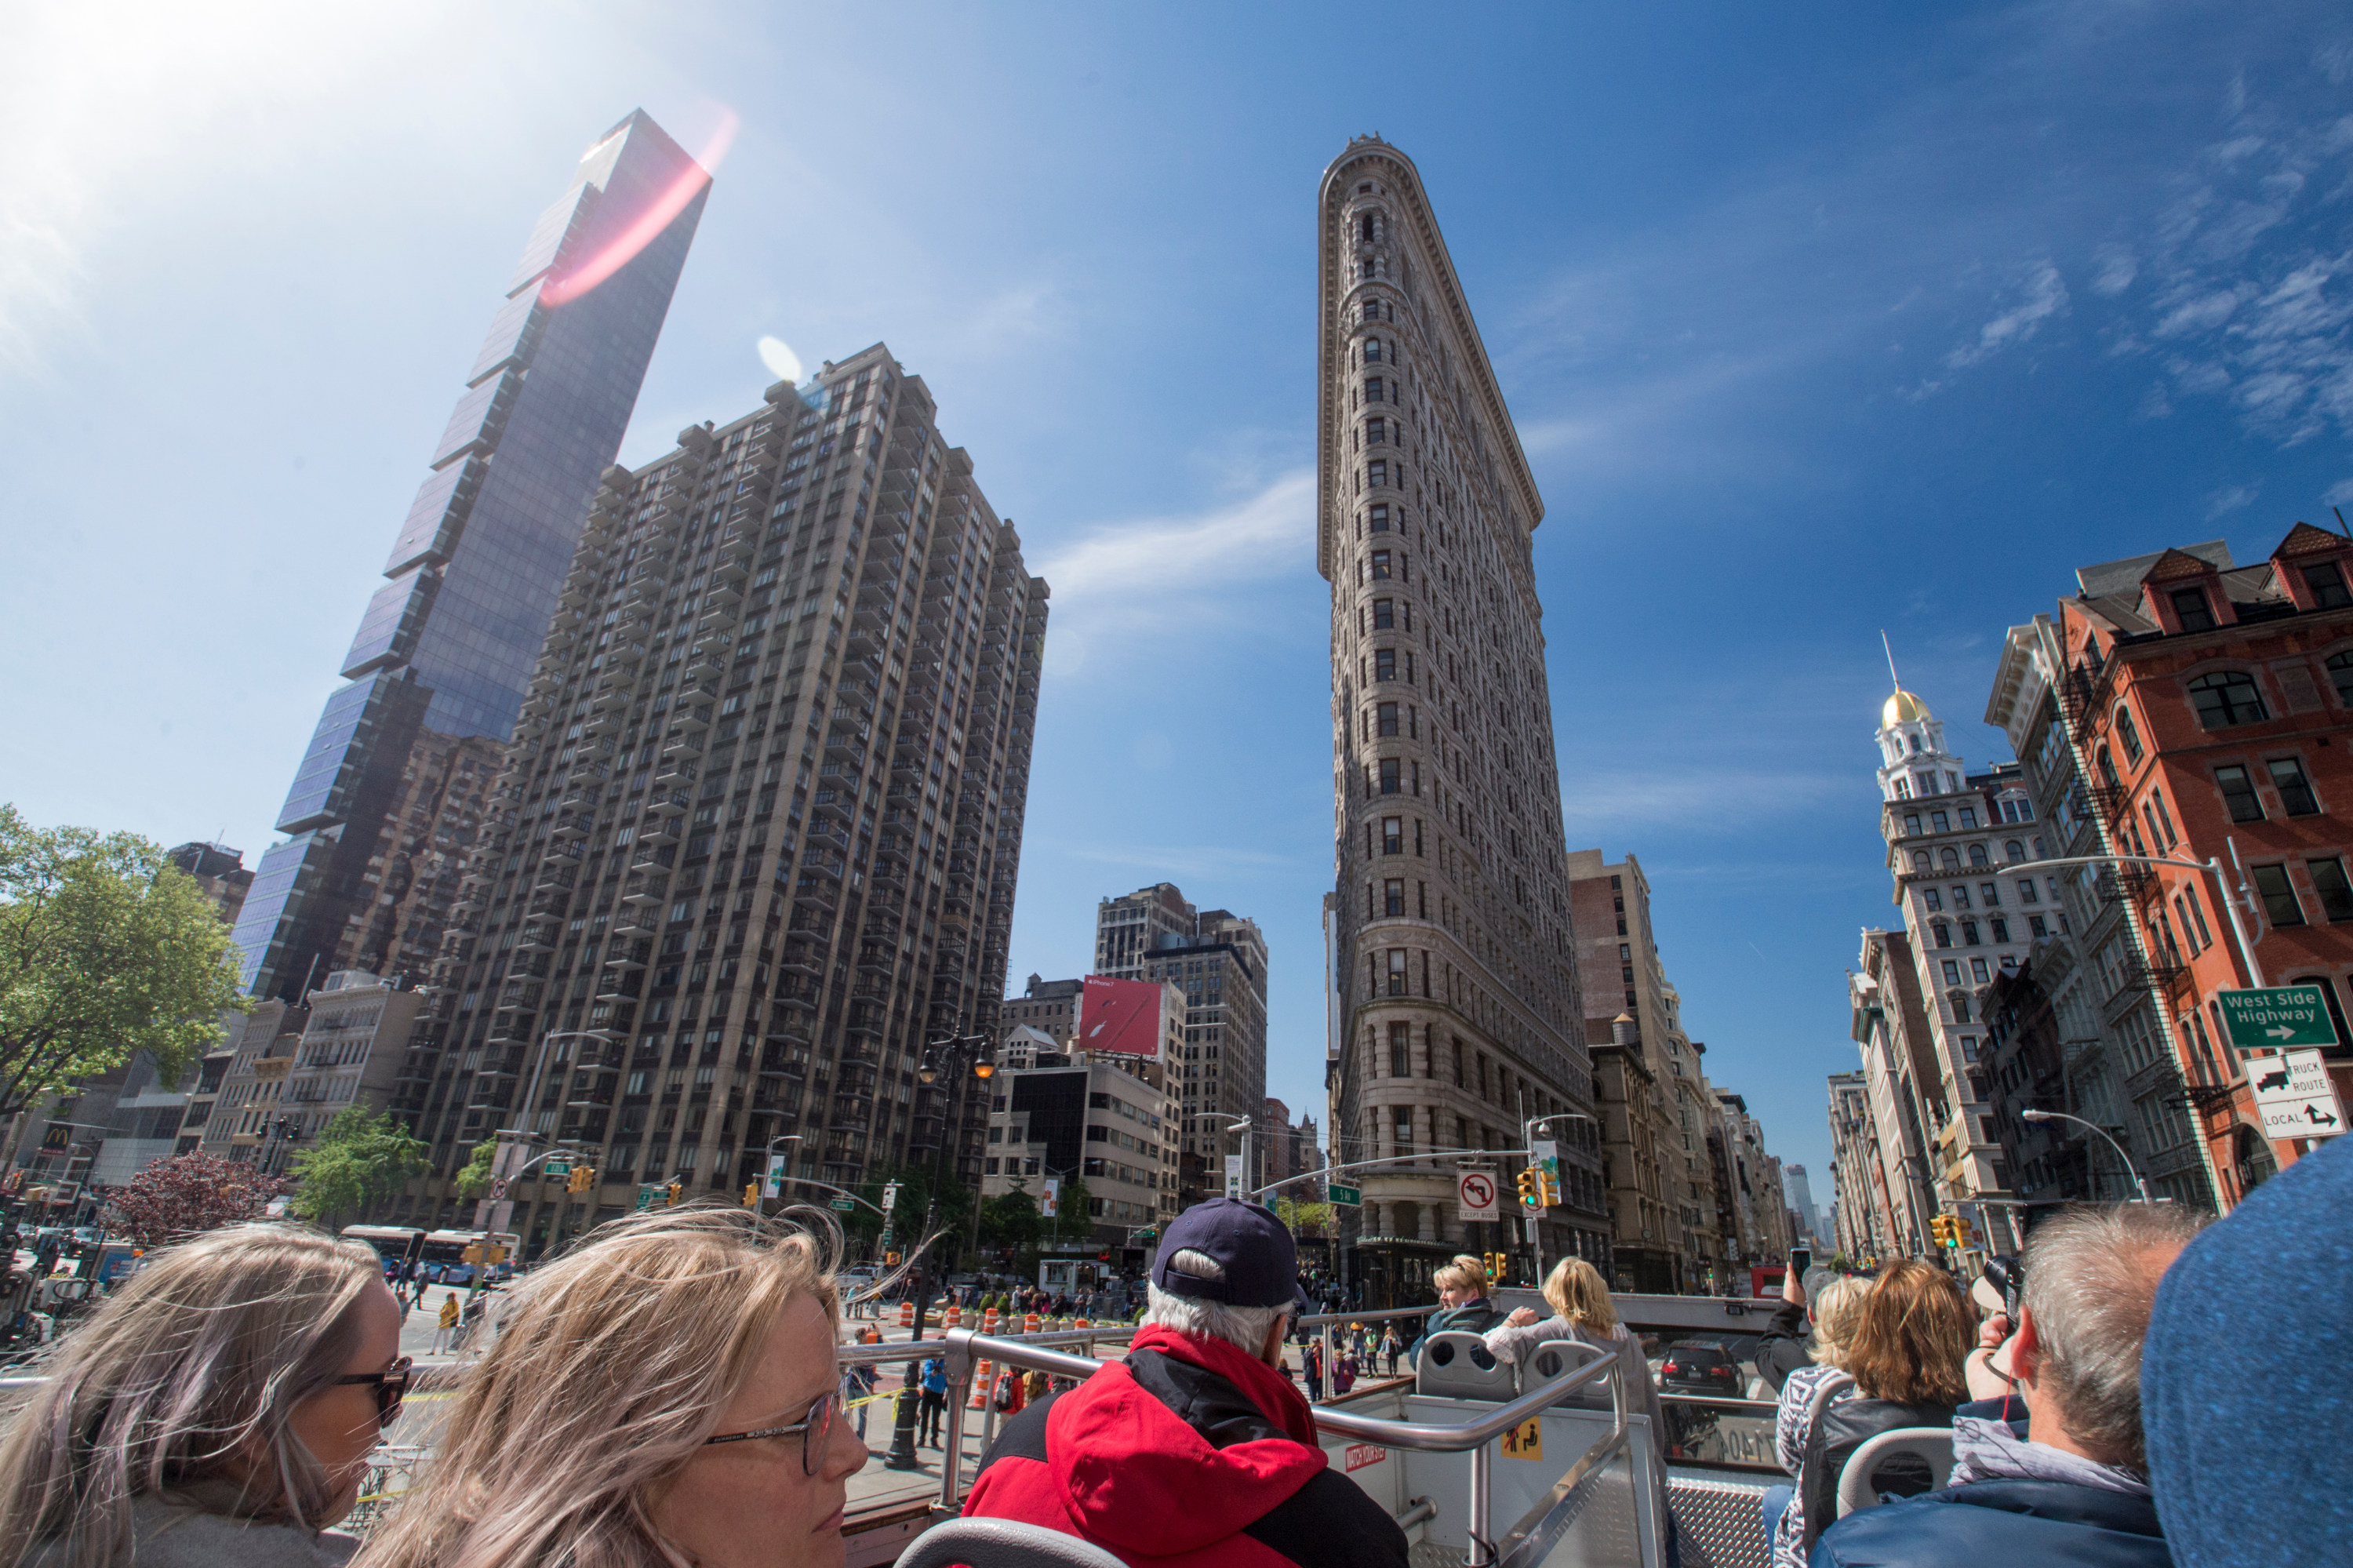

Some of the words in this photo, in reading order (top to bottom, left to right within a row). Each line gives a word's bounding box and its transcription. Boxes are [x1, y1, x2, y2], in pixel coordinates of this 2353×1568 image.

[2226, 995, 2271, 1008] West
[2277, 992, 2316, 1006] Side
[2237, 1009, 2315, 1025] Highway
[2288, 1061, 2321, 1075] TRUCK
[2293, 1079, 2327, 1092] ROUTE
[2264, 1114, 2304, 1126] LOCAL
[1340, 1188, 1344, 1200] 5
[1344, 1190, 1351, 1202] Av
[1347, 1446, 1362, 1469] WATCH
[1362, 1444, 1375, 1464] YOUR
